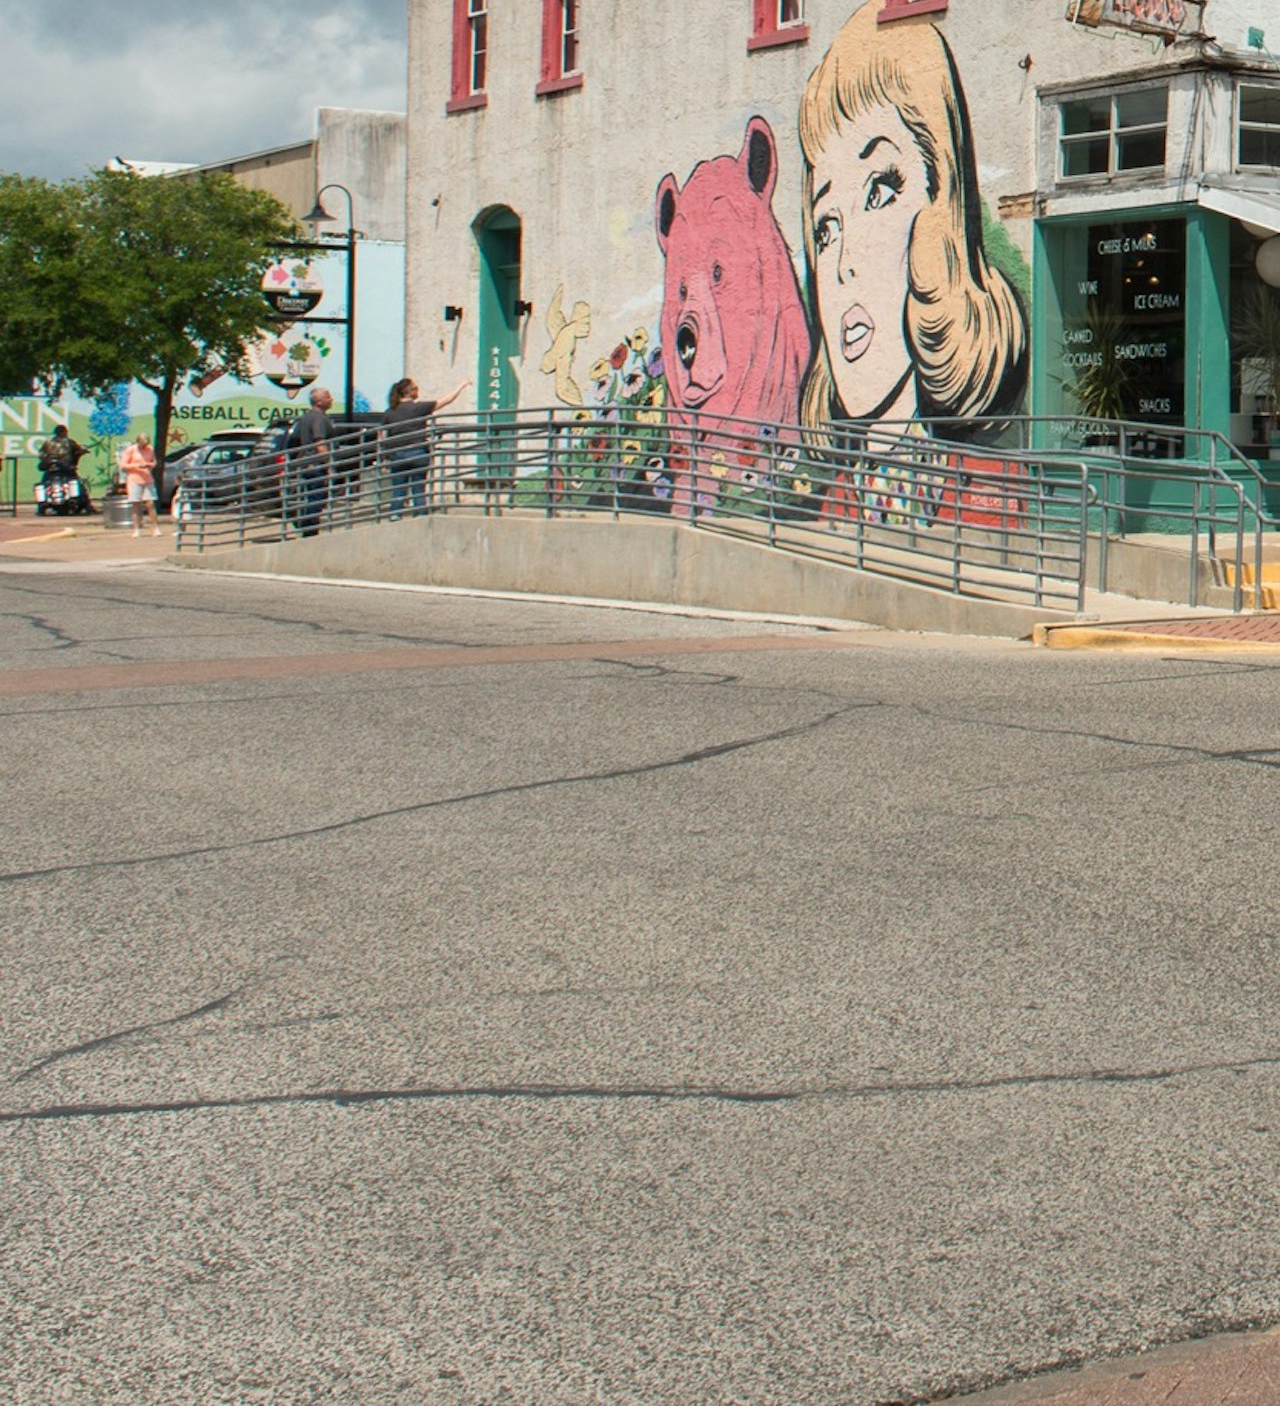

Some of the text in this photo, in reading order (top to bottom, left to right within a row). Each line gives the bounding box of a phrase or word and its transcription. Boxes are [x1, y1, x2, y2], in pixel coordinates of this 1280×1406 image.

[1134, 292, 1180, 310] ICE CREAM
[1062, 328, 1094, 344] CANNED
[1062, 352, 1103, 367] COCKTAILS
[1114, 343, 1168, 360] SANDWICHES
[489, 356, 502, 400] 1844
[168, 406, 250, 421] ASEBALL
[1139, 398, 1171, 413] SNACKS
